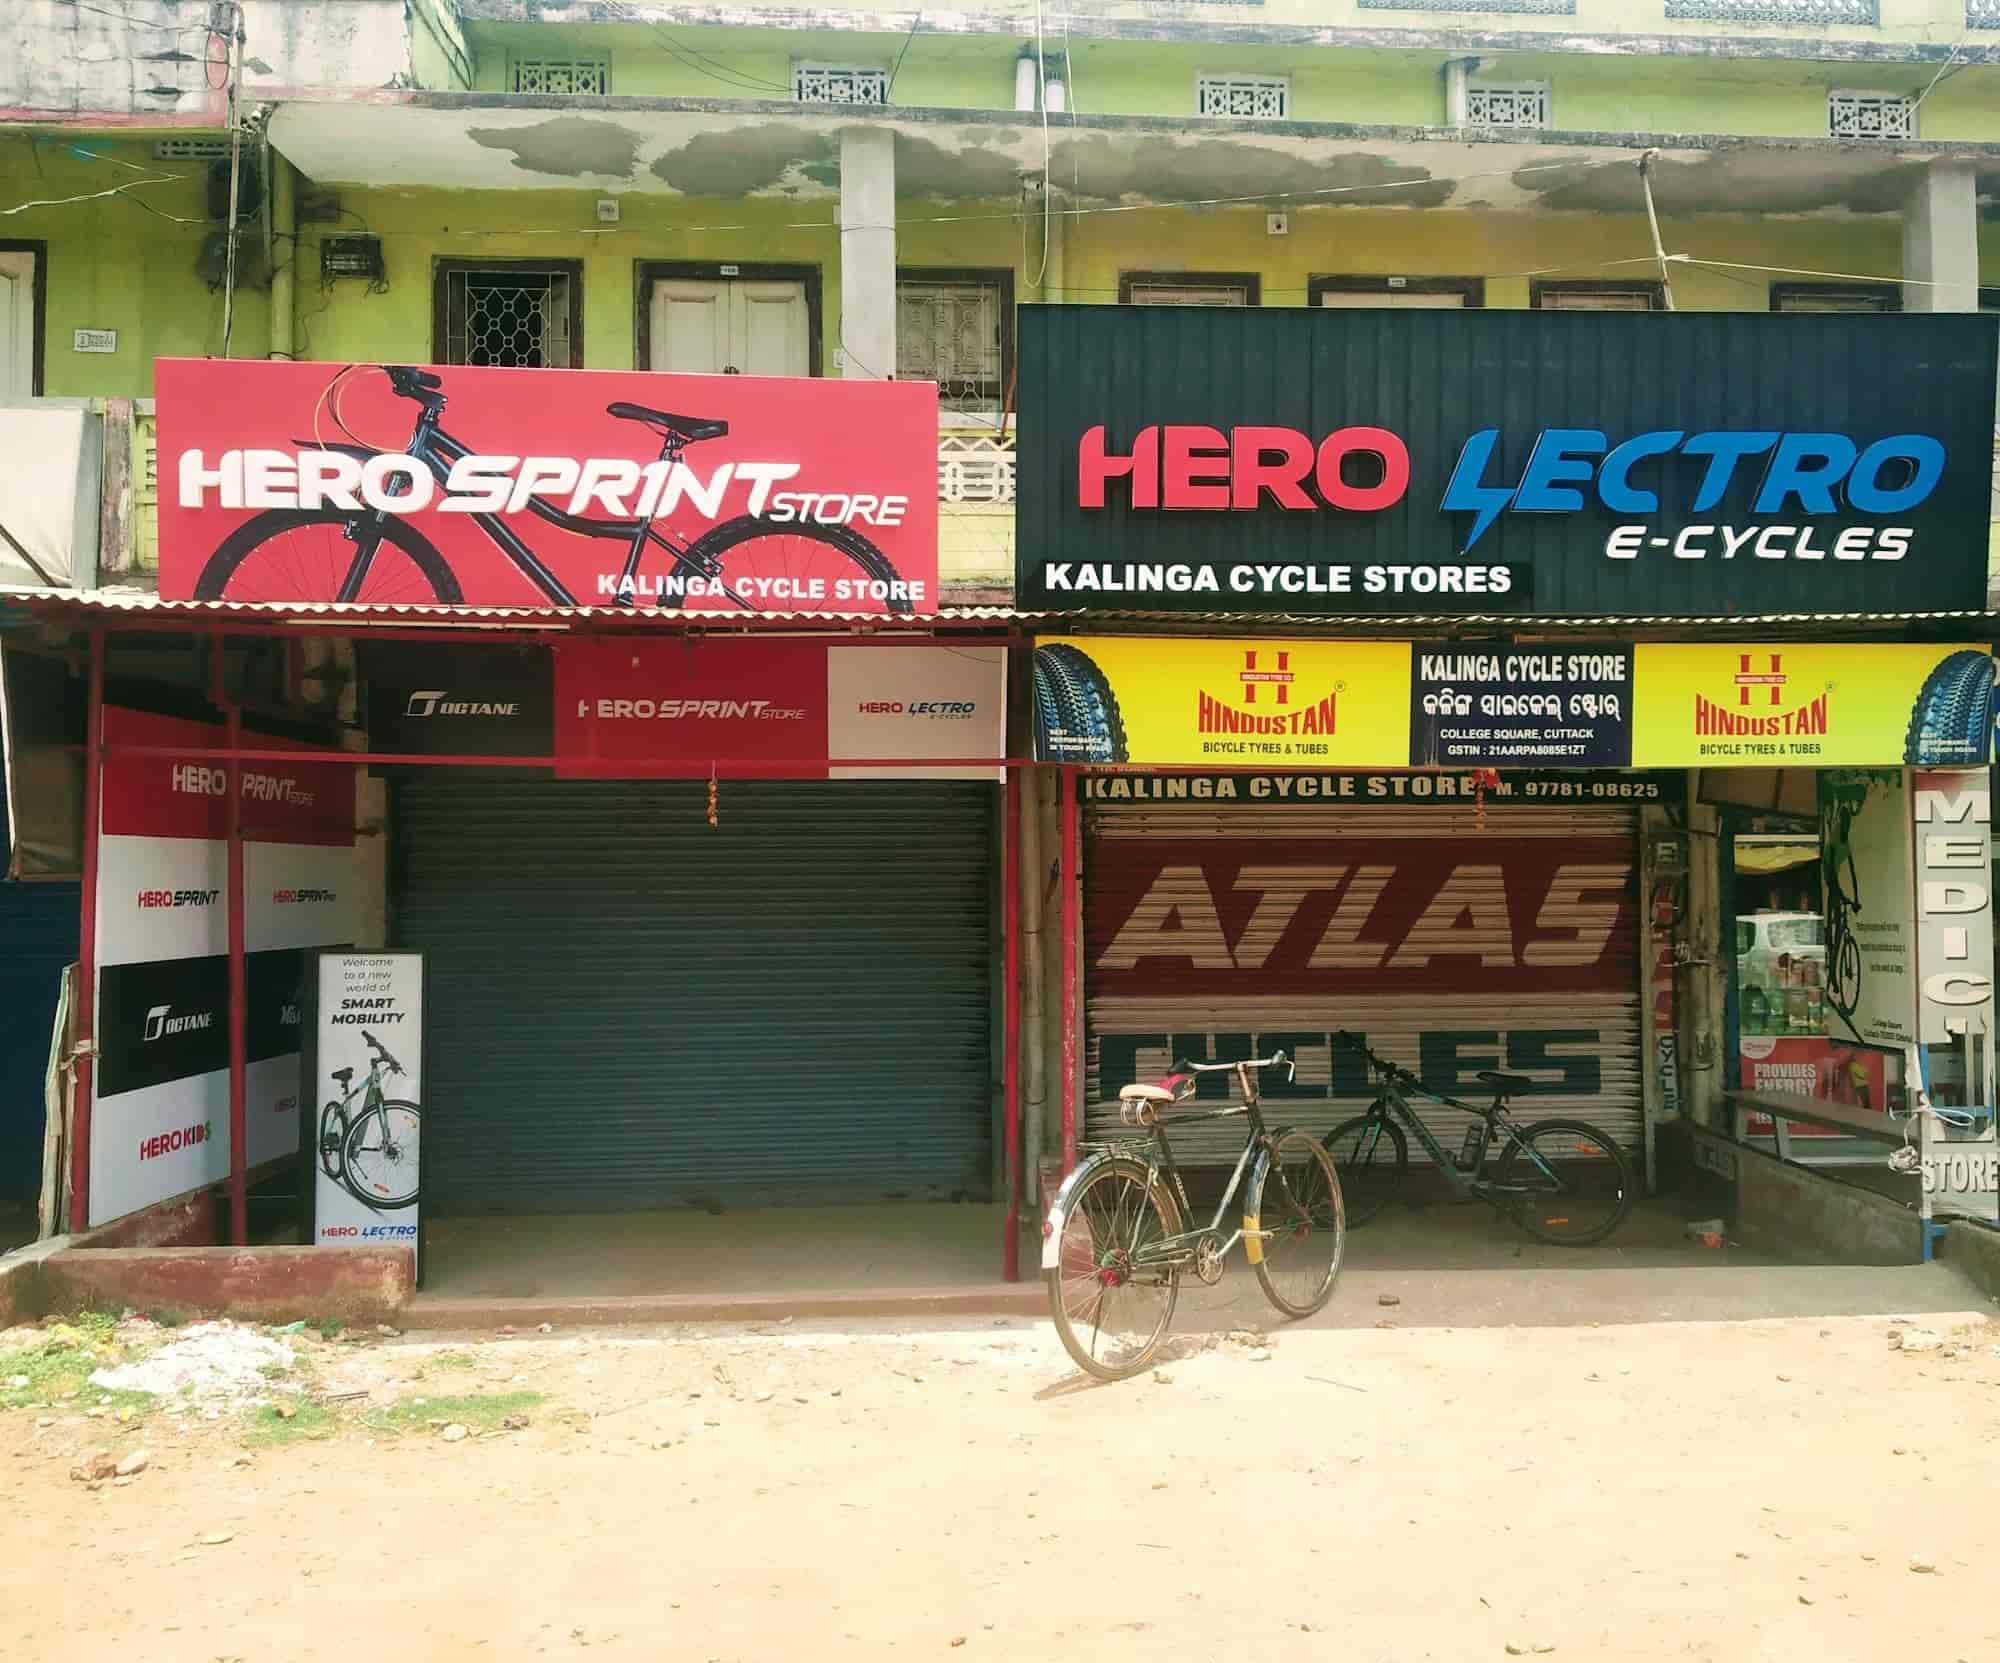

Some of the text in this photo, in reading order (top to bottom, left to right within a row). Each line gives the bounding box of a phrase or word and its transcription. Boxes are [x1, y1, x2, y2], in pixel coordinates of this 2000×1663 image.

[1079, 425, 1410, 511] HERO
[179, 449, 909, 525] HERO SPRINT STORE
[1605, 525, 1915, 560] E-CYCLES
[597, 574, 925, 601] KALINGA CYCLE STORE
[1045, 563, 1511, 593] KALINGA CYCLE STORES
[1421, 655, 1625, 681] KALINGA CYCLE STORE
[440, 703, 520, 716] OCTANE
[577, 699, 806, 720] HERO SPRINT STORE
[859, 702, 903, 713] HERO
[1199, 689, 1336, 735] HINDUSTAN
[1696, 692, 1827, 735] HINDUSTAN
[1440, 729, 1594, 741] COLLEGE SQUARE, CUTTACK
[1203, 742, 1328, 755] BICYCLE TYRES & TUBES
[1447, 744, 1481, 755] GSTIN
[1700, 743, 1821, 755] BICYCLE TYRES & TUBES
[172, 764, 226, 795] HERO
[240, 773, 297, 801] PRINT
[1085, 776, 1658, 798] KALINGA CYCLE STORE M. 97781-08625
[138, 890, 219, 908] HERO SPRINT
[1096, 864, 1632, 969] ATLAS
[1914, 790, 1993, 1143] MEDIC
[346, 982, 392, 992] world of
[341, 998, 395, 1009] SMART
[166, 1012, 212, 1034] OCTANE
[332, 1013, 405, 1024] MOBILITY
[1754, 1063, 1817, 1078] PROVIDES
[140, 1120, 212, 1160] HERO KIDS
[1922, 1153, 1998, 1193] STORE
[321, 1227, 358, 1237] HERO
